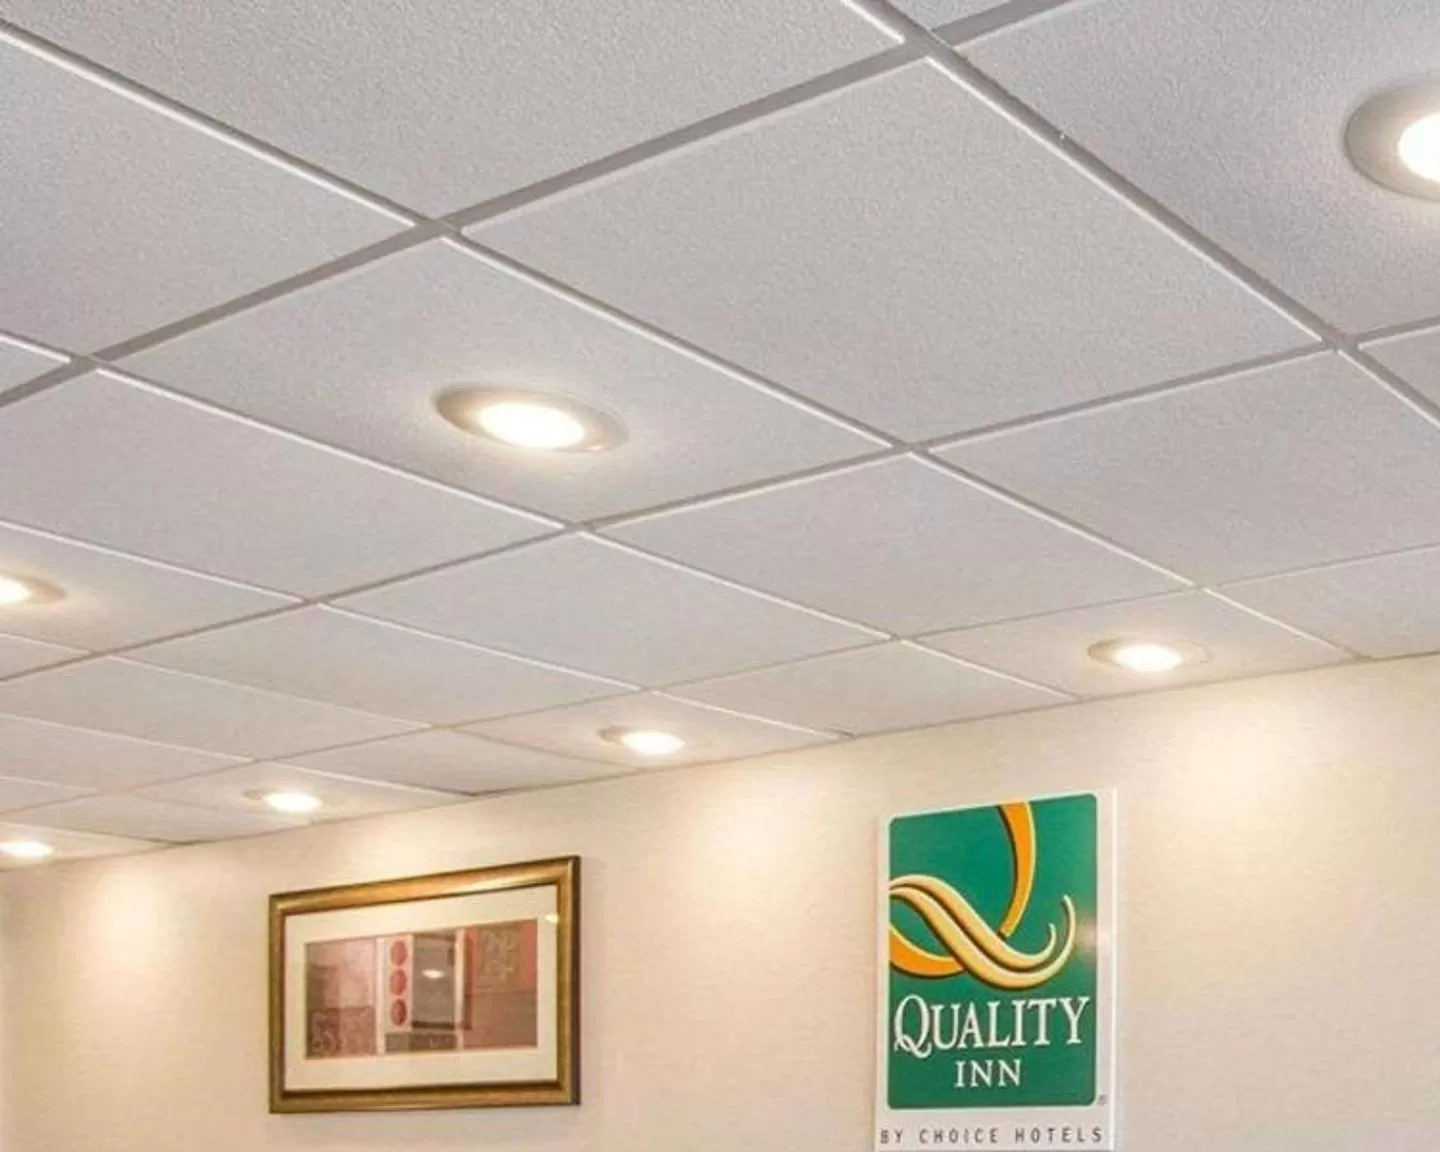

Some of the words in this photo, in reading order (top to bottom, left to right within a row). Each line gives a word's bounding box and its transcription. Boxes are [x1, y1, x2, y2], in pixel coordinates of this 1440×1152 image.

[893, 995, 1090, 1058] QUALITY
[954, 1059, 1021, 1088] INN
[880, 1129, 904, 1145] BY
[918, 1127, 999, 1144] CHOICE
[1015, 1126, 1103, 1143] HOTELS
